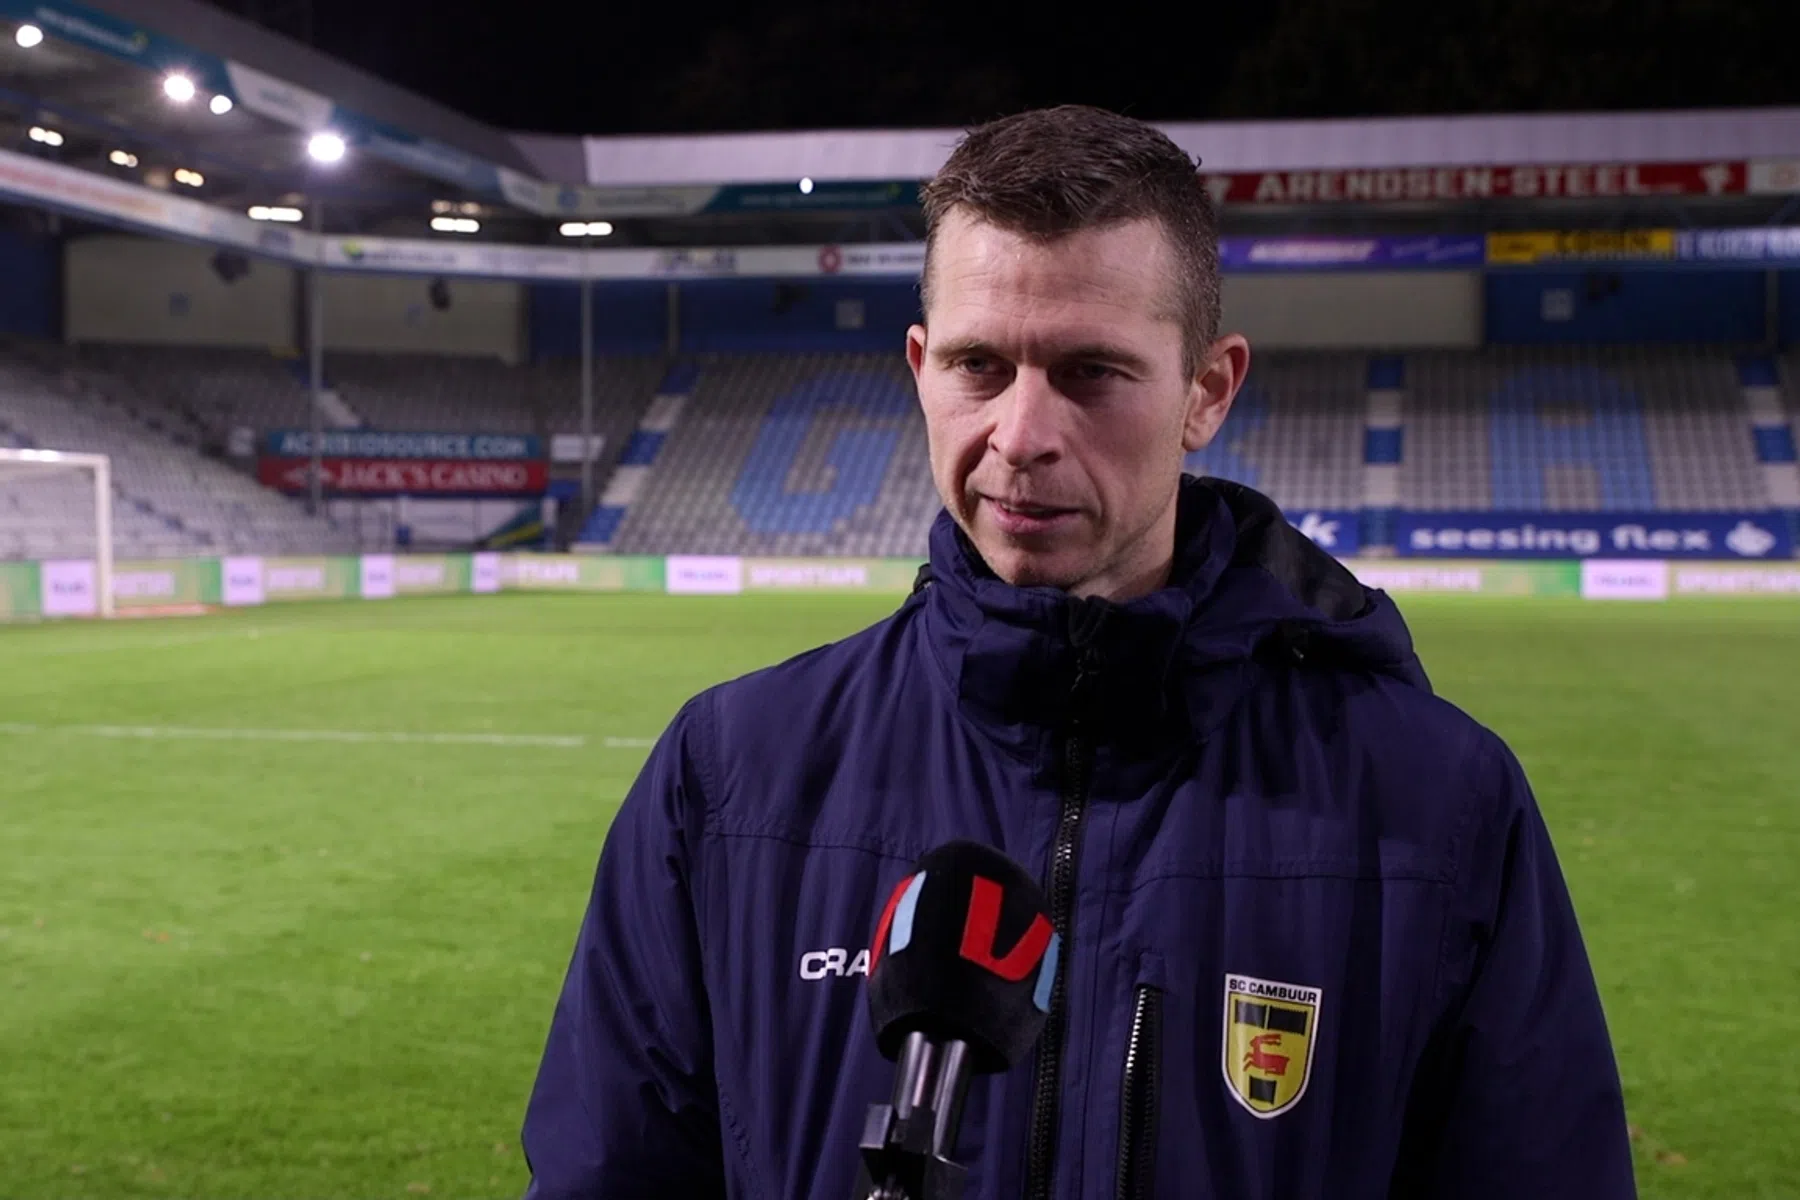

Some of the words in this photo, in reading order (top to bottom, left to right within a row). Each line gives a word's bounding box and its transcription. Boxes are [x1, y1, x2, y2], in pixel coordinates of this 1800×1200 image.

[339, 461, 430, 489] JACK'S
[431, 462, 528, 489] CASINO
[1410, 523, 1600, 554] seesing
[1613, 523, 1713, 551] flex
[1229, 978, 1247, 992] SC
[1249, 983, 1317, 1003] CAMBUUR
